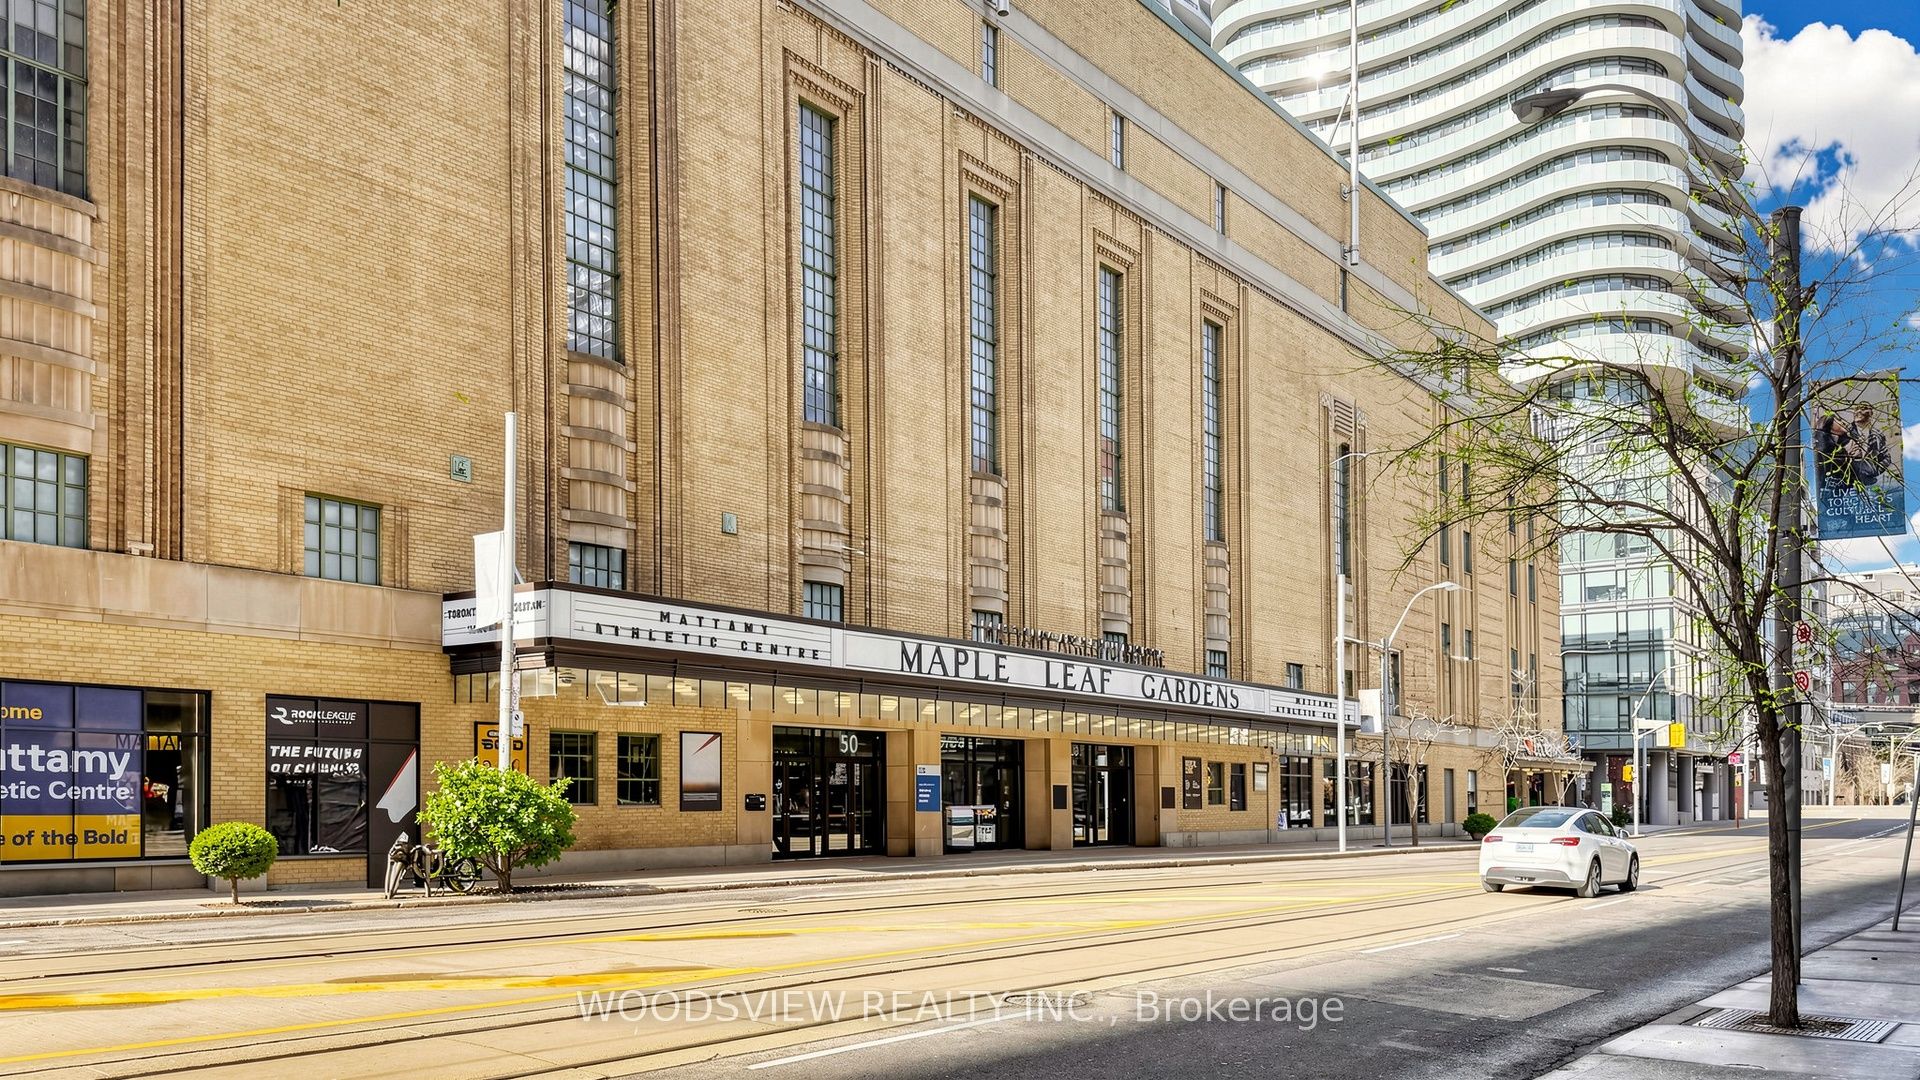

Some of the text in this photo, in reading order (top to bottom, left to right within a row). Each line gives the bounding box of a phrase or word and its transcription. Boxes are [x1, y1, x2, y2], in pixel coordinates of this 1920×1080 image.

[1832, 488, 1857, 497] LIVE
[1855, 512, 1893, 524] HEART
[660, 611, 768, 635] MATTAMY
[596, 622, 819, 660] ATHLETIC CENTRE
[899, 640, 1010, 683] MAPLE
[1045, 660, 1112, 695] LEAF
[1141, 674, 1240, 710] GARDENS
[270, 745, 301, 758] THE
[840, 734, 858, 754] 50
[0, 743, 131, 781] ttamy
[48, 781, 131, 801] Centre
[12, 830, 35, 846] of
[41, 830, 79, 846] the
[84, 829, 128, 845] Bold
